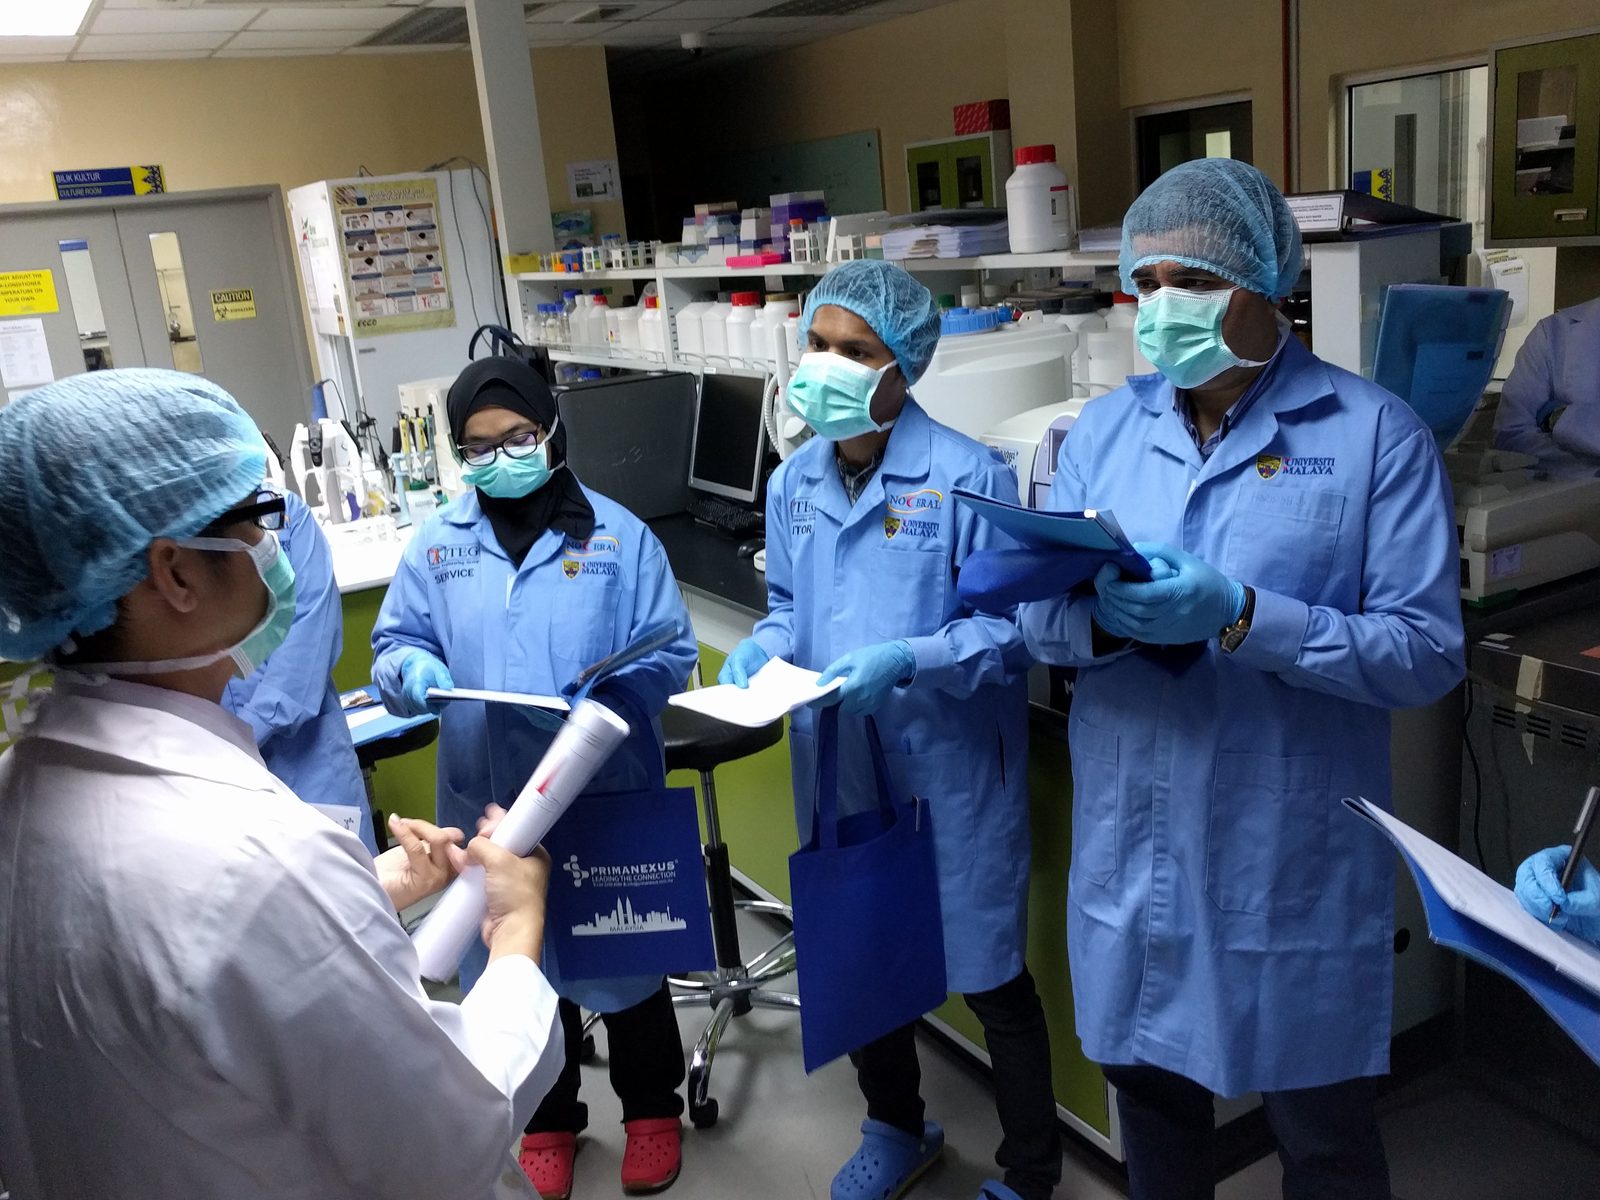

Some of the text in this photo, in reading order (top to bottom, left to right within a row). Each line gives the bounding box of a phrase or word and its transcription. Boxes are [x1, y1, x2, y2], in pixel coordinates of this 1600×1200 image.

[56, 172, 101, 183] BILIK KULTUR
[59, 187, 102, 197] CULTURE ROOM
[214, 291, 251, 303] CAUTION
[1283, 457, 1335, 467] UNIVERSITI
[1282, 466, 1334, 476] MALAYA
[901, 518, 940, 532] UNIVERSITI
[900, 526, 938, 539] MALAYA
[581, 561, 618, 570] UNIVERSITI
[434, 568, 475, 585] SERVICE
[581, 567, 617, 577] MALAYA
[590, 860, 675, 876] PRIMANEXUS
[591, 870, 676, 883] LEADING THE CONNECTION
[609, 924, 645, 932] MALAYSIA
